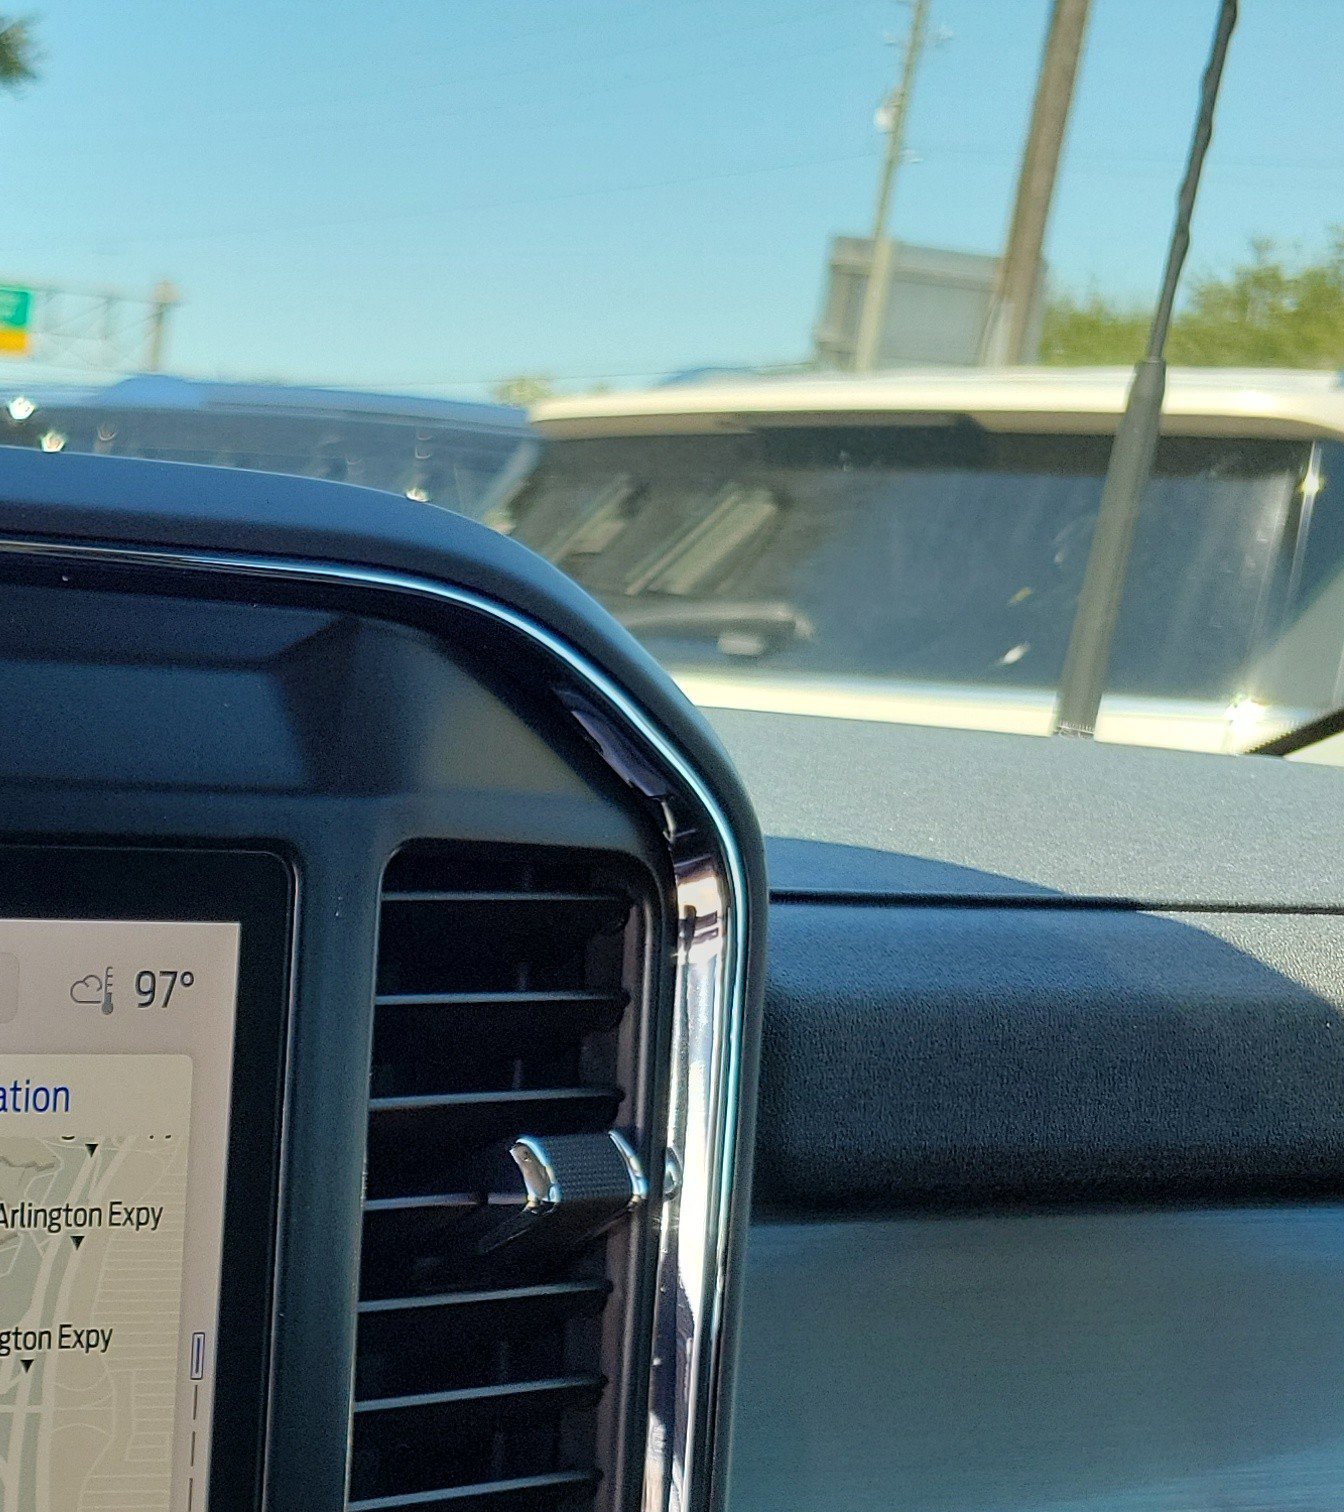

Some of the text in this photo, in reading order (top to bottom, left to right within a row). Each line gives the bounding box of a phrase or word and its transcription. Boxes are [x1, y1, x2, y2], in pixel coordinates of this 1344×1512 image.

[134, 971, 195, 1008] 97°
[109, 1201, 163, 1231] Expy
[58, 1325, 113, 1353] Expy
